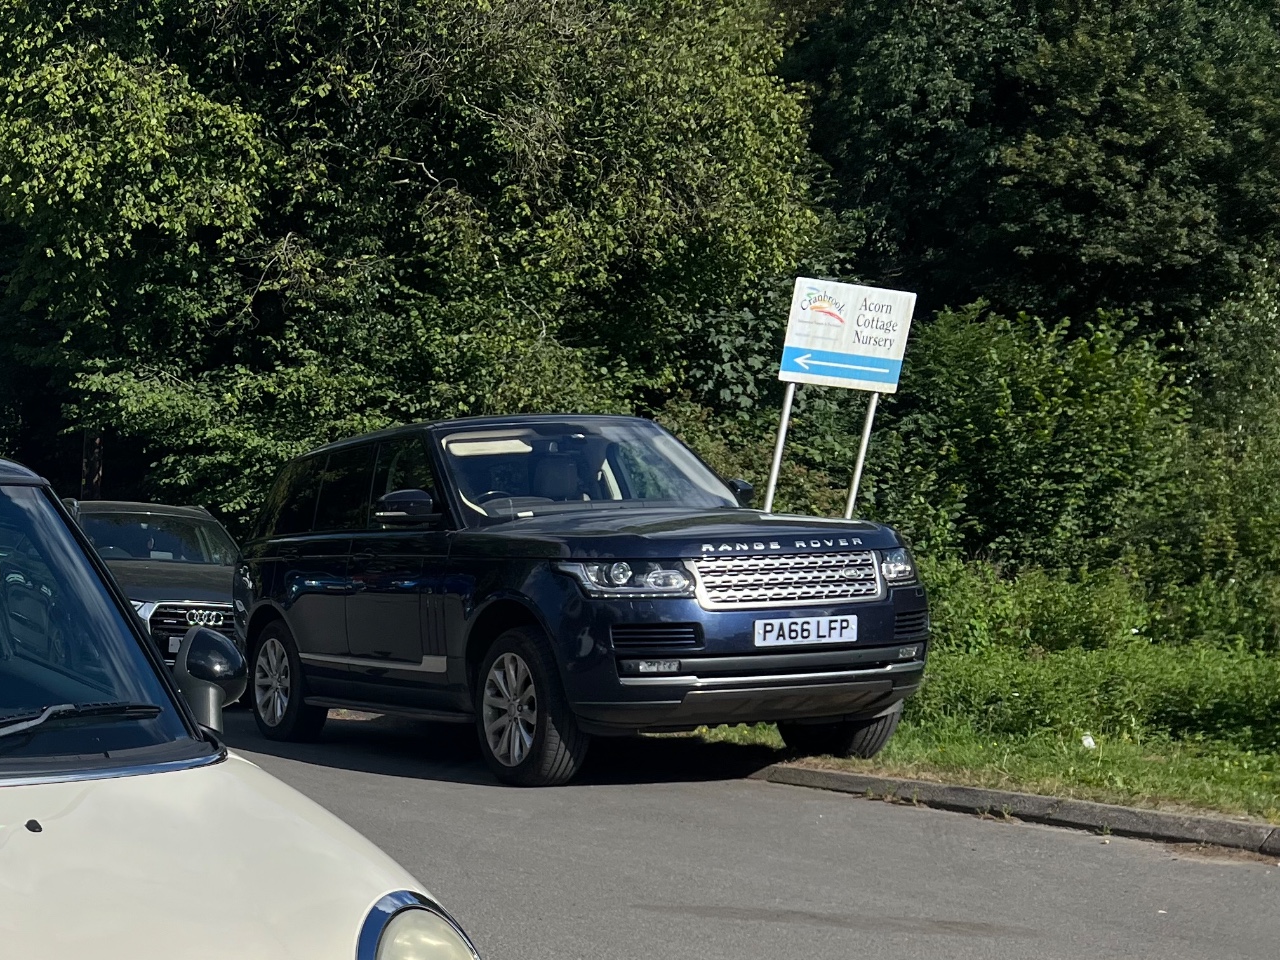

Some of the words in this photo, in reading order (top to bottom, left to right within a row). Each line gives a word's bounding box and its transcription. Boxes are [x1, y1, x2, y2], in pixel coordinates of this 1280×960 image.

[801, 291, 845, 314] Cranbrook
[859, 297, 892, 314] Acorn
[856, 314, 898, 333] Cottage
[852, 330, 895, 350] Nursery
[702, 542, 780, 551] RANGE
[796, 538, 862, 548] ROVER
[763, 622, 810, 641] PA66
[816, 619, 850, 639] LFP
